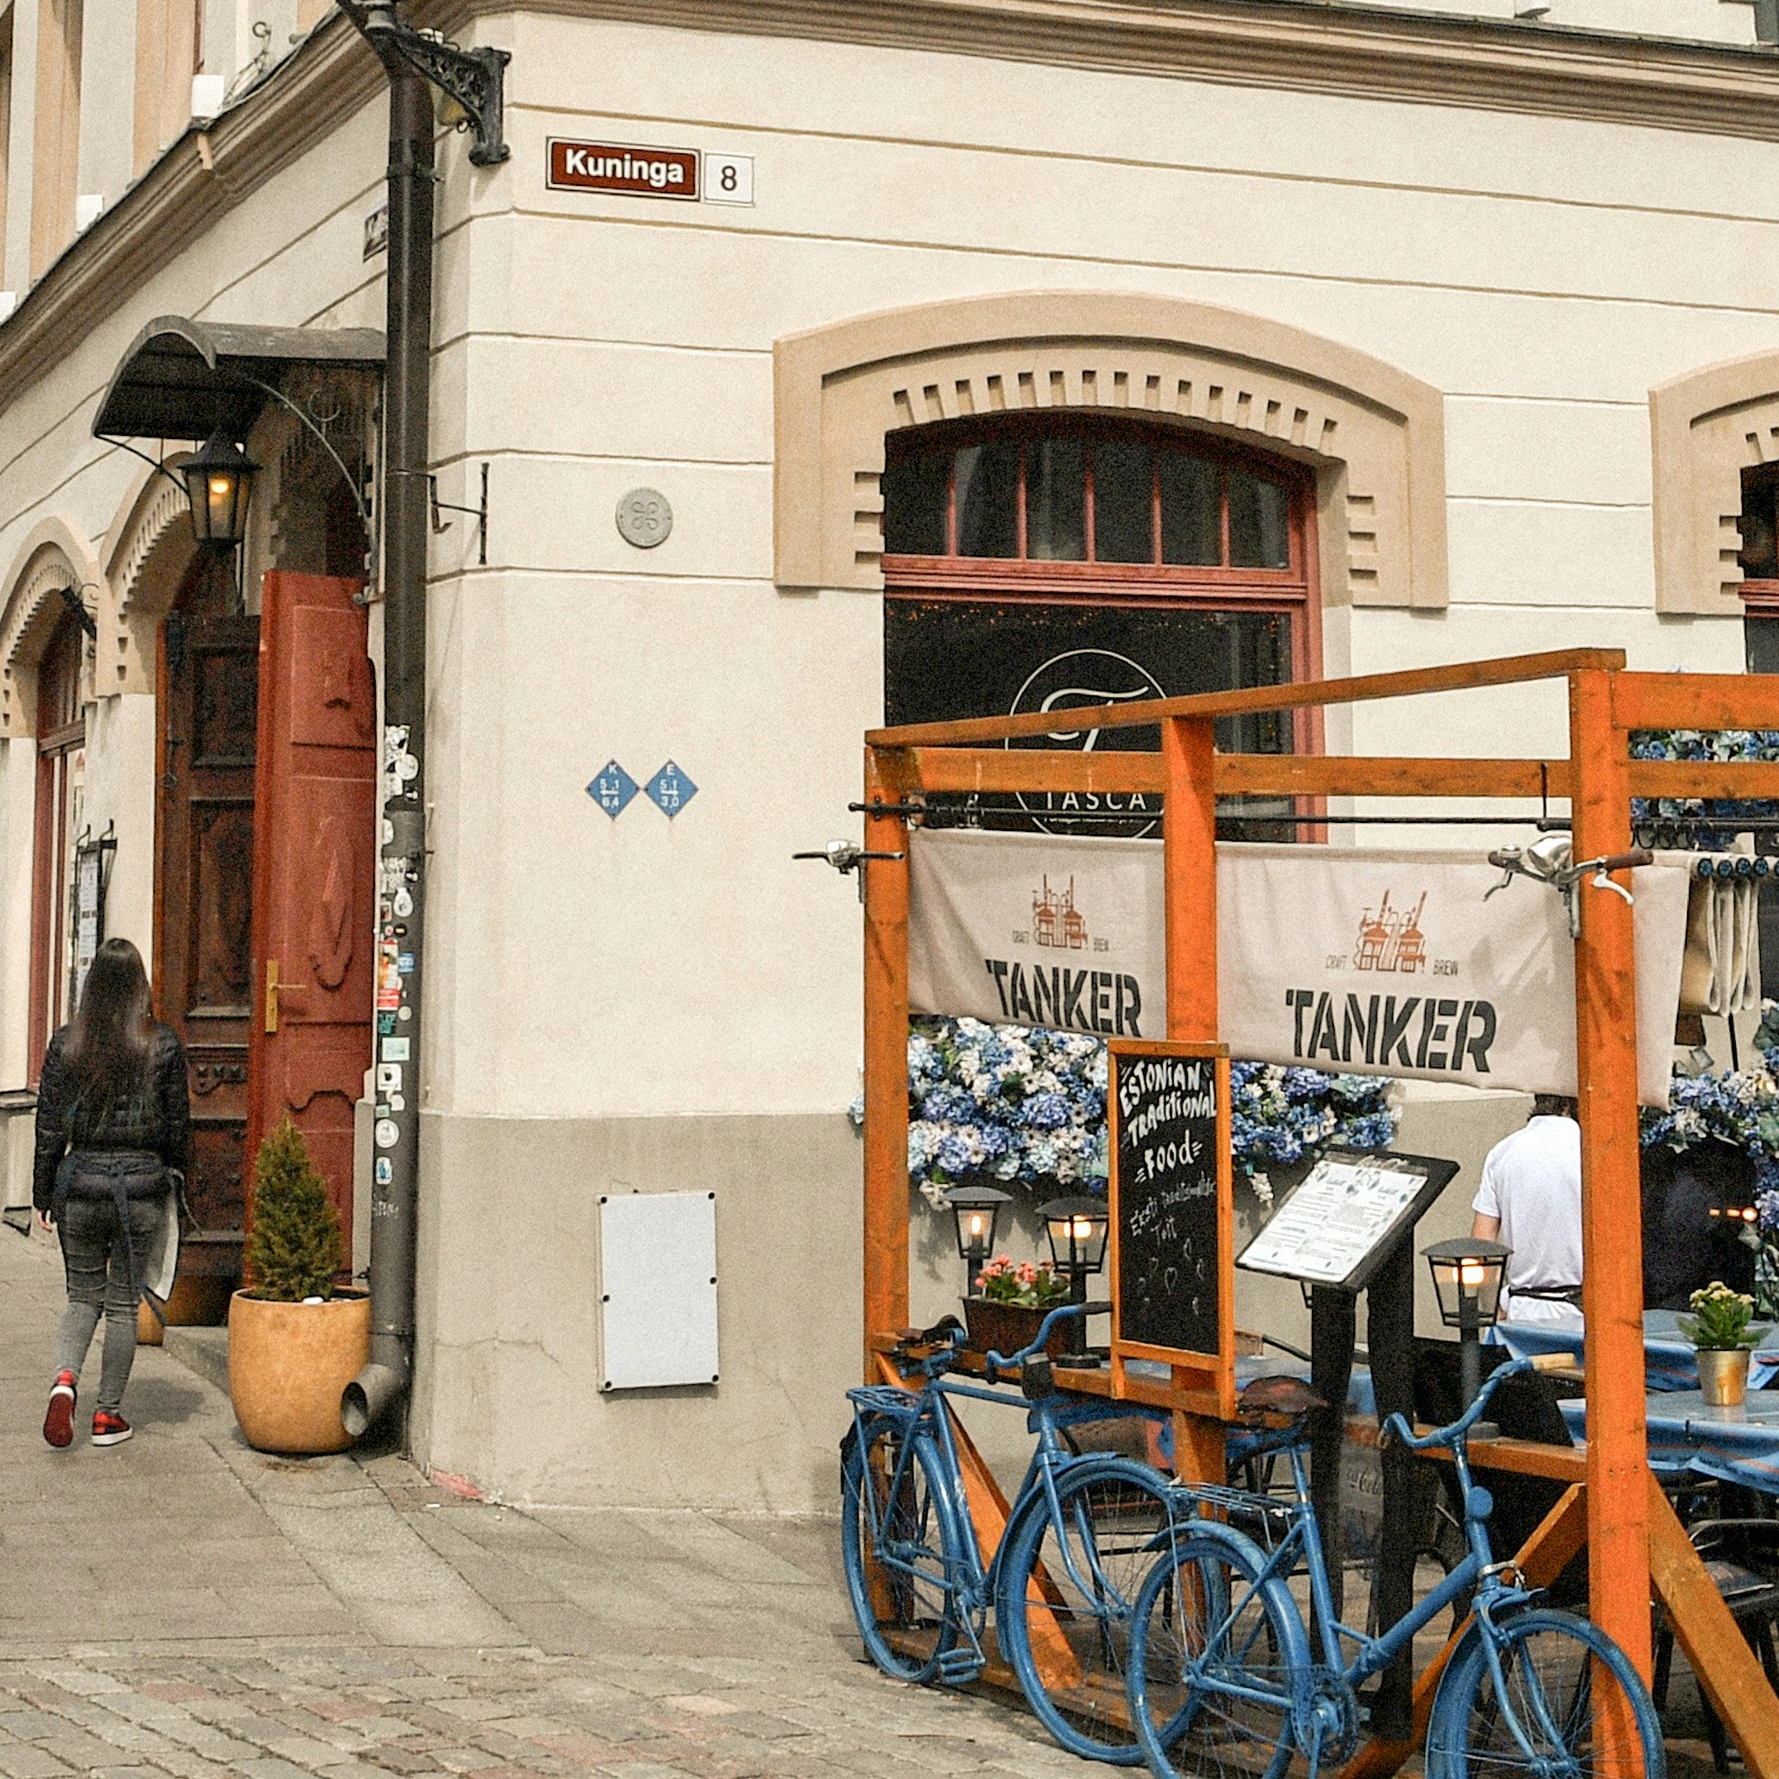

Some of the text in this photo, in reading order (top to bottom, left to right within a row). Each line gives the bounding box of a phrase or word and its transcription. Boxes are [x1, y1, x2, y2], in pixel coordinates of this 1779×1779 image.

[565, 148, 684, 188] Kuninga
[721, 165, 737, 191] 8
[608, 764, 618, 775] K
[666, 764, 675, 776] E
[1432, 959, 1459, 976] BREW
[985, 958, 1142, 1038] TANKER
[1285, 988, 1497, 1073] TANKER
